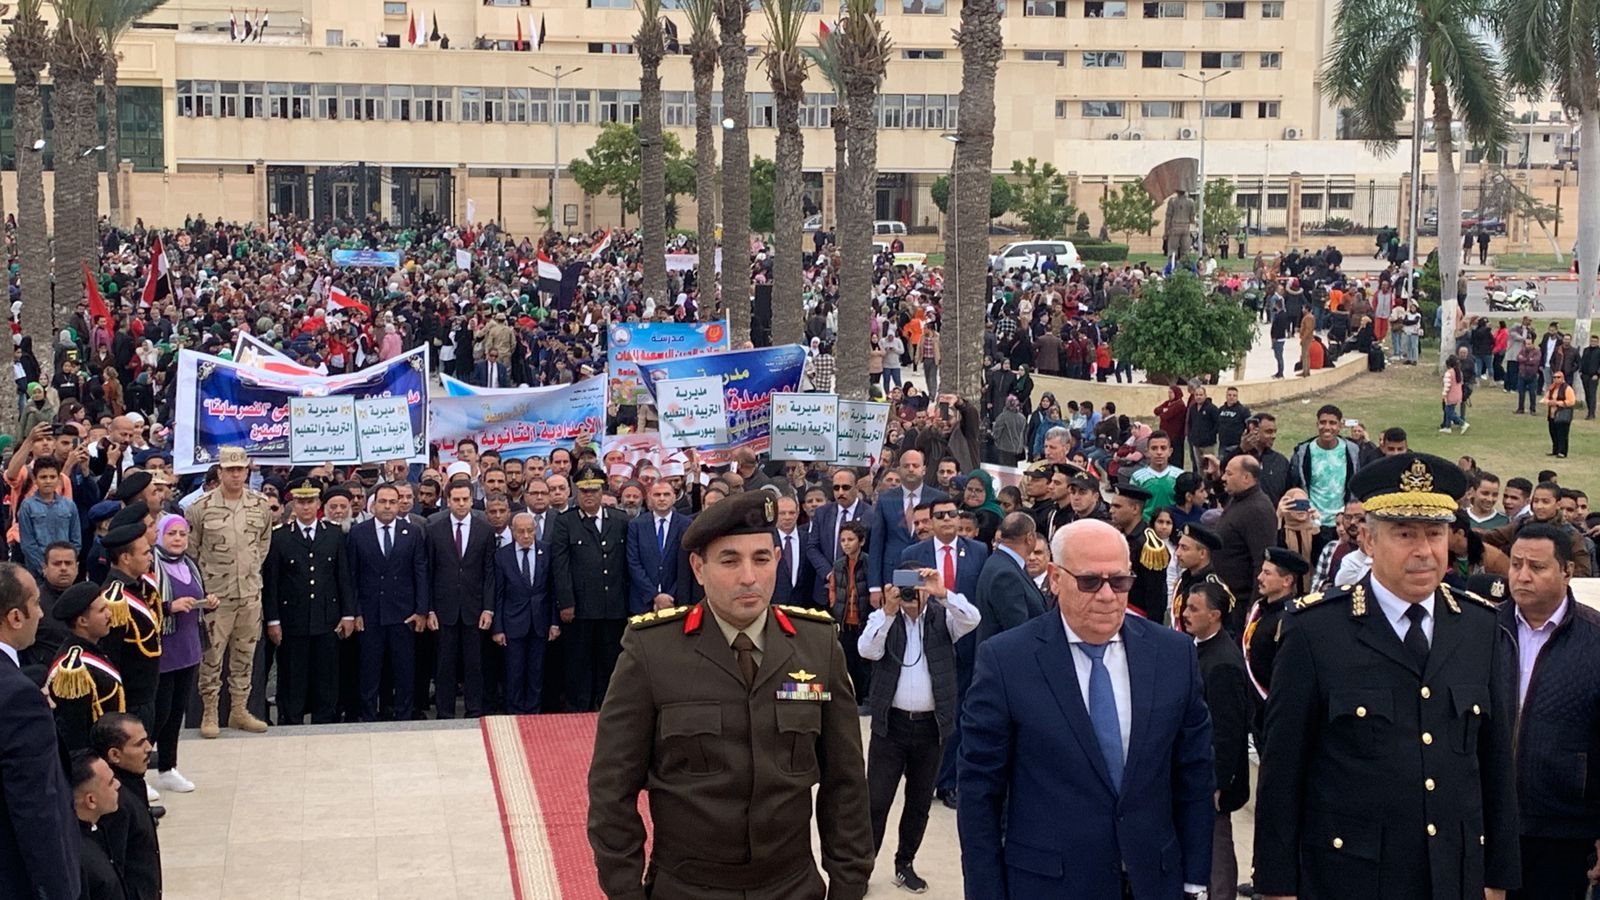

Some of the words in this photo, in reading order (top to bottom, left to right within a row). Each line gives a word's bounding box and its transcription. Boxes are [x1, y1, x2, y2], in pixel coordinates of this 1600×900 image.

[674, 386, 707, 400] مديرية
[307, 403, 338, 418] مديرية
[369, 405, 395, 419] مديرية
[663, 407, 693, 422] والتعليم
[694, 403, 721, 419] التربية
[790, 401, 821, 416] مديرية
[850, 408, 875, 424] مديرية
[294, 423, 325, 438] والتعليم
[326, 421, 353, 436] التربية
[361, 424, 387, 439] والتعليم
[387, 422, 410, 436] التربية
[775, 422, 806, 435] والتعليم
[808, 421, 835, 437] التربية
[838, 428, 860, 441] والتعلي
